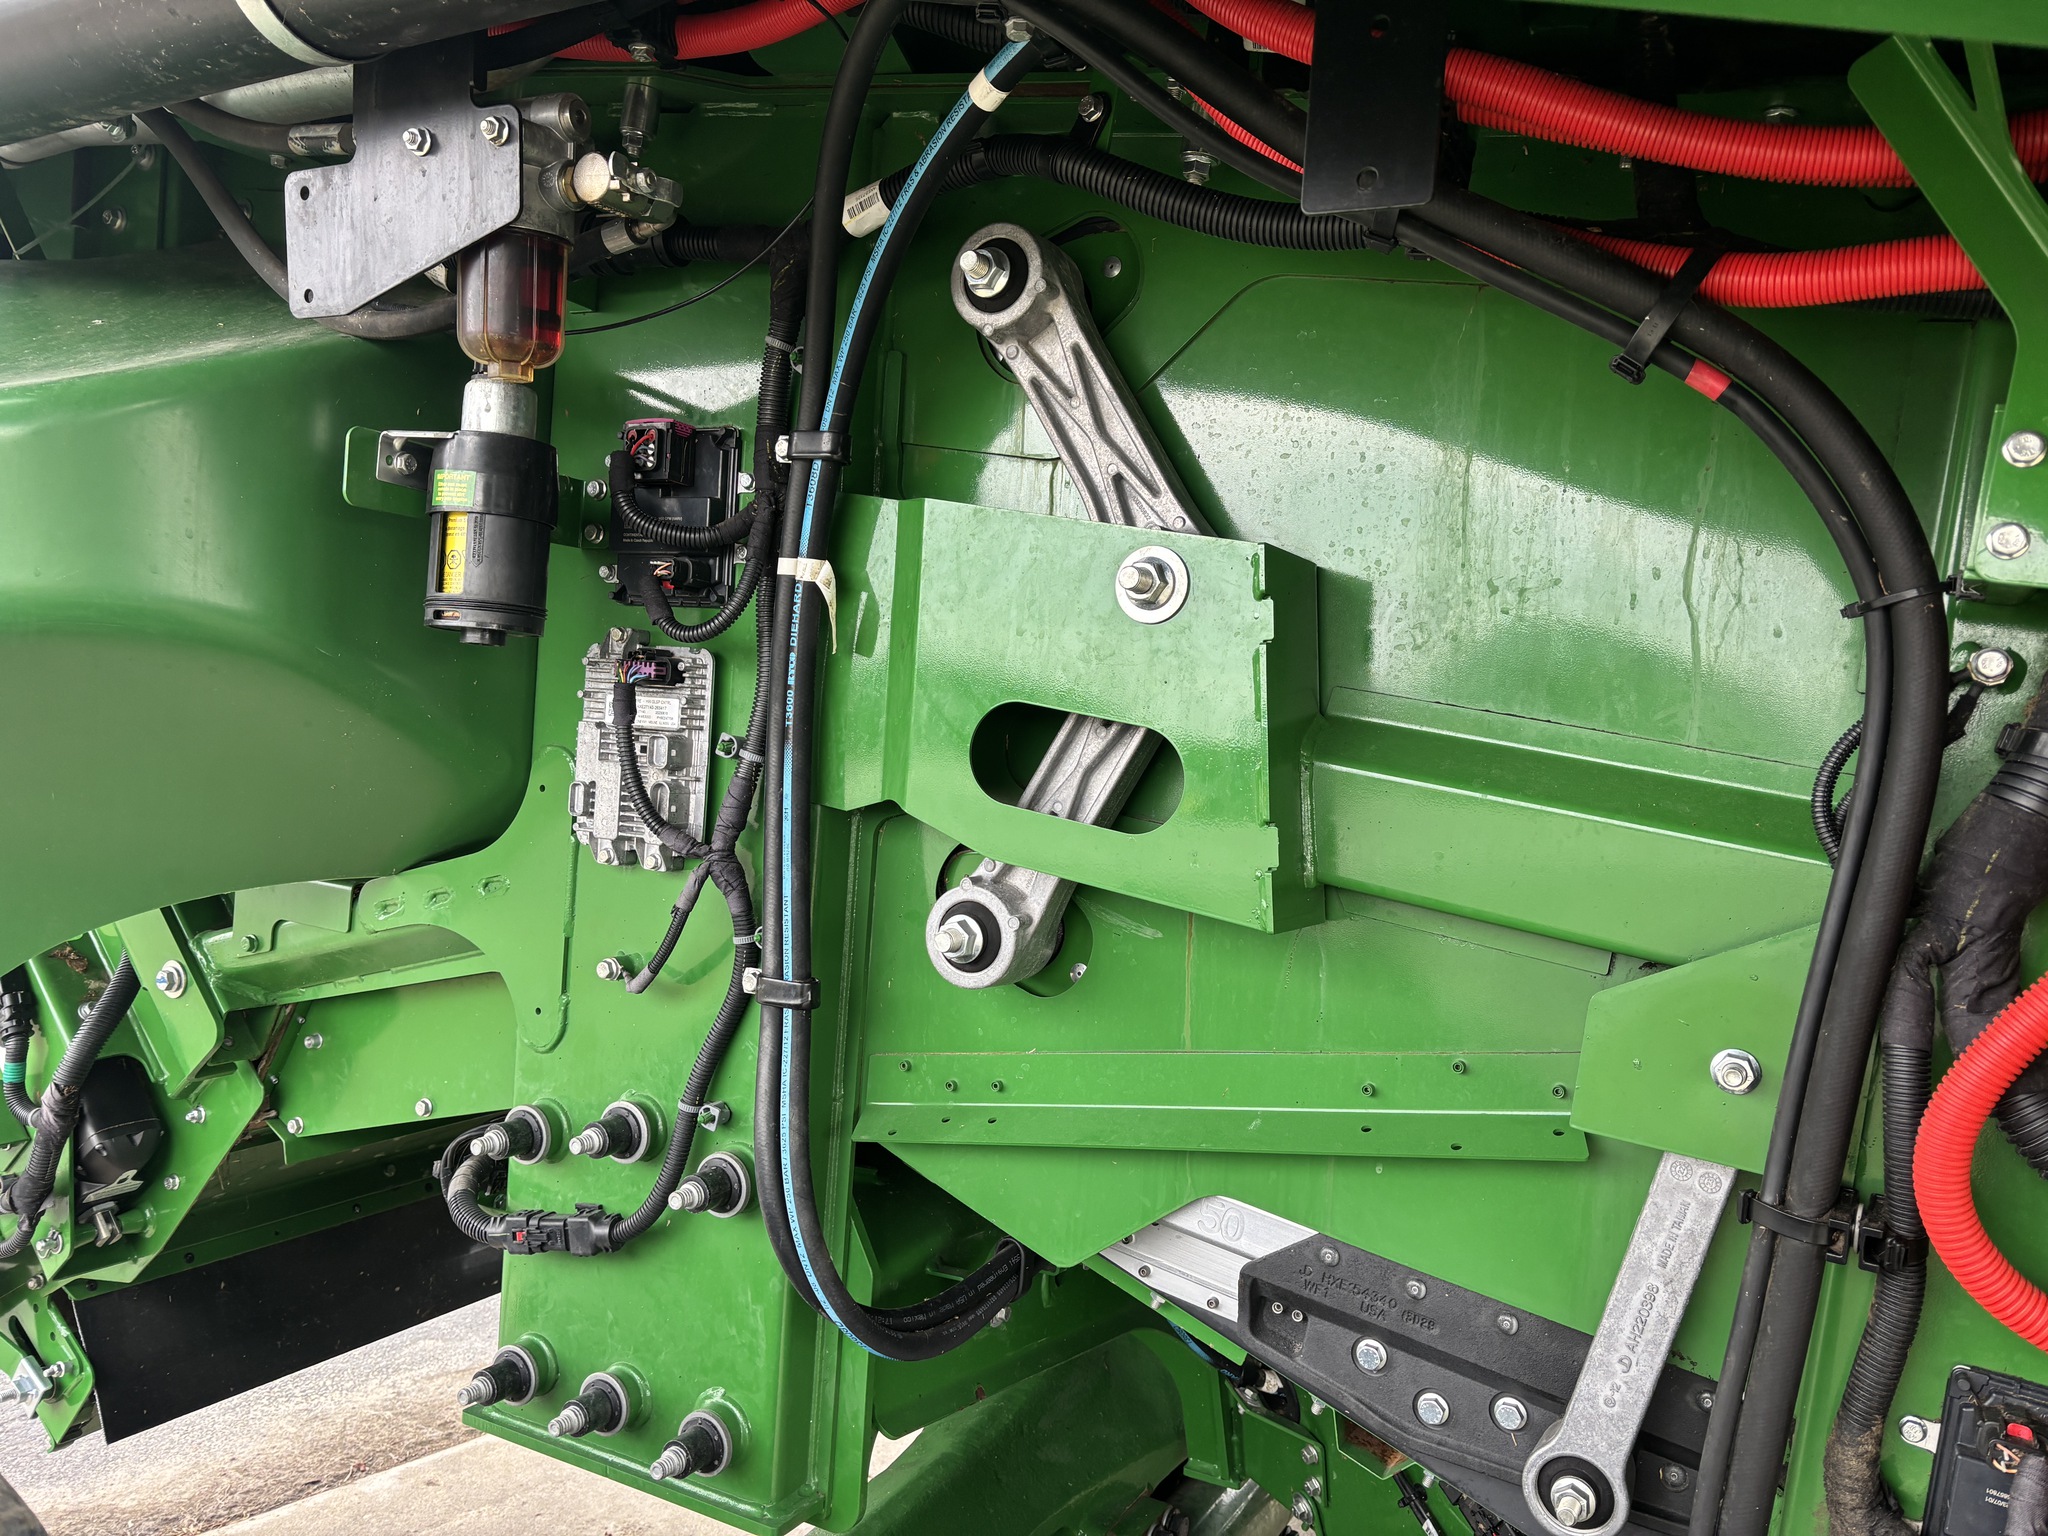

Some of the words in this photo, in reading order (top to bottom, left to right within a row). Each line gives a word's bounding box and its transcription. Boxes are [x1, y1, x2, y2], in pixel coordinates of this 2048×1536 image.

[824, 388, 835, 413] DN12
[831, 364, 841, 386] MAX
[837, 347, 846, 364] WP
[844, 330, 852, 346] 250
[848, 308, 858, 330] BAR
[856, 282, 866, 304] 3625
[863, 266, 873, 282] PSI
[870, 238, 885, 264] MSHA
[900, 177, 915, 202] FRAS
[918, 124, 947, 168] ABRASION
[790, 582, 803, 647] DIEHARD
[787, 651, 796, 686] RYCO
[784, 690, 794, 727] T3600
[788, 1207, 796, 1224] WP
[1197, 1198, 1245, 1243] 50
[1672, 1201, 1691, 1230] TAIWAN
[792, 1226, 802, 1248] MAX
[1670, 1230, 1679, 1242] IN
[800, 1252, 812, 1278] DN12
[1656, 1242, 1676, 1270] MADE
[976, 1264, 1008, 1292] Engineered
[955, 1295, 968, 1305] USA
[968, 1288, 976, 1297] in
[903, 1312, 928, 1324] Mexico
[939, 1302, 955, 1312] Made
[1360, 1301, 1387, 1322] USA
[1626, 1282, 1660, 1354] AH220398
